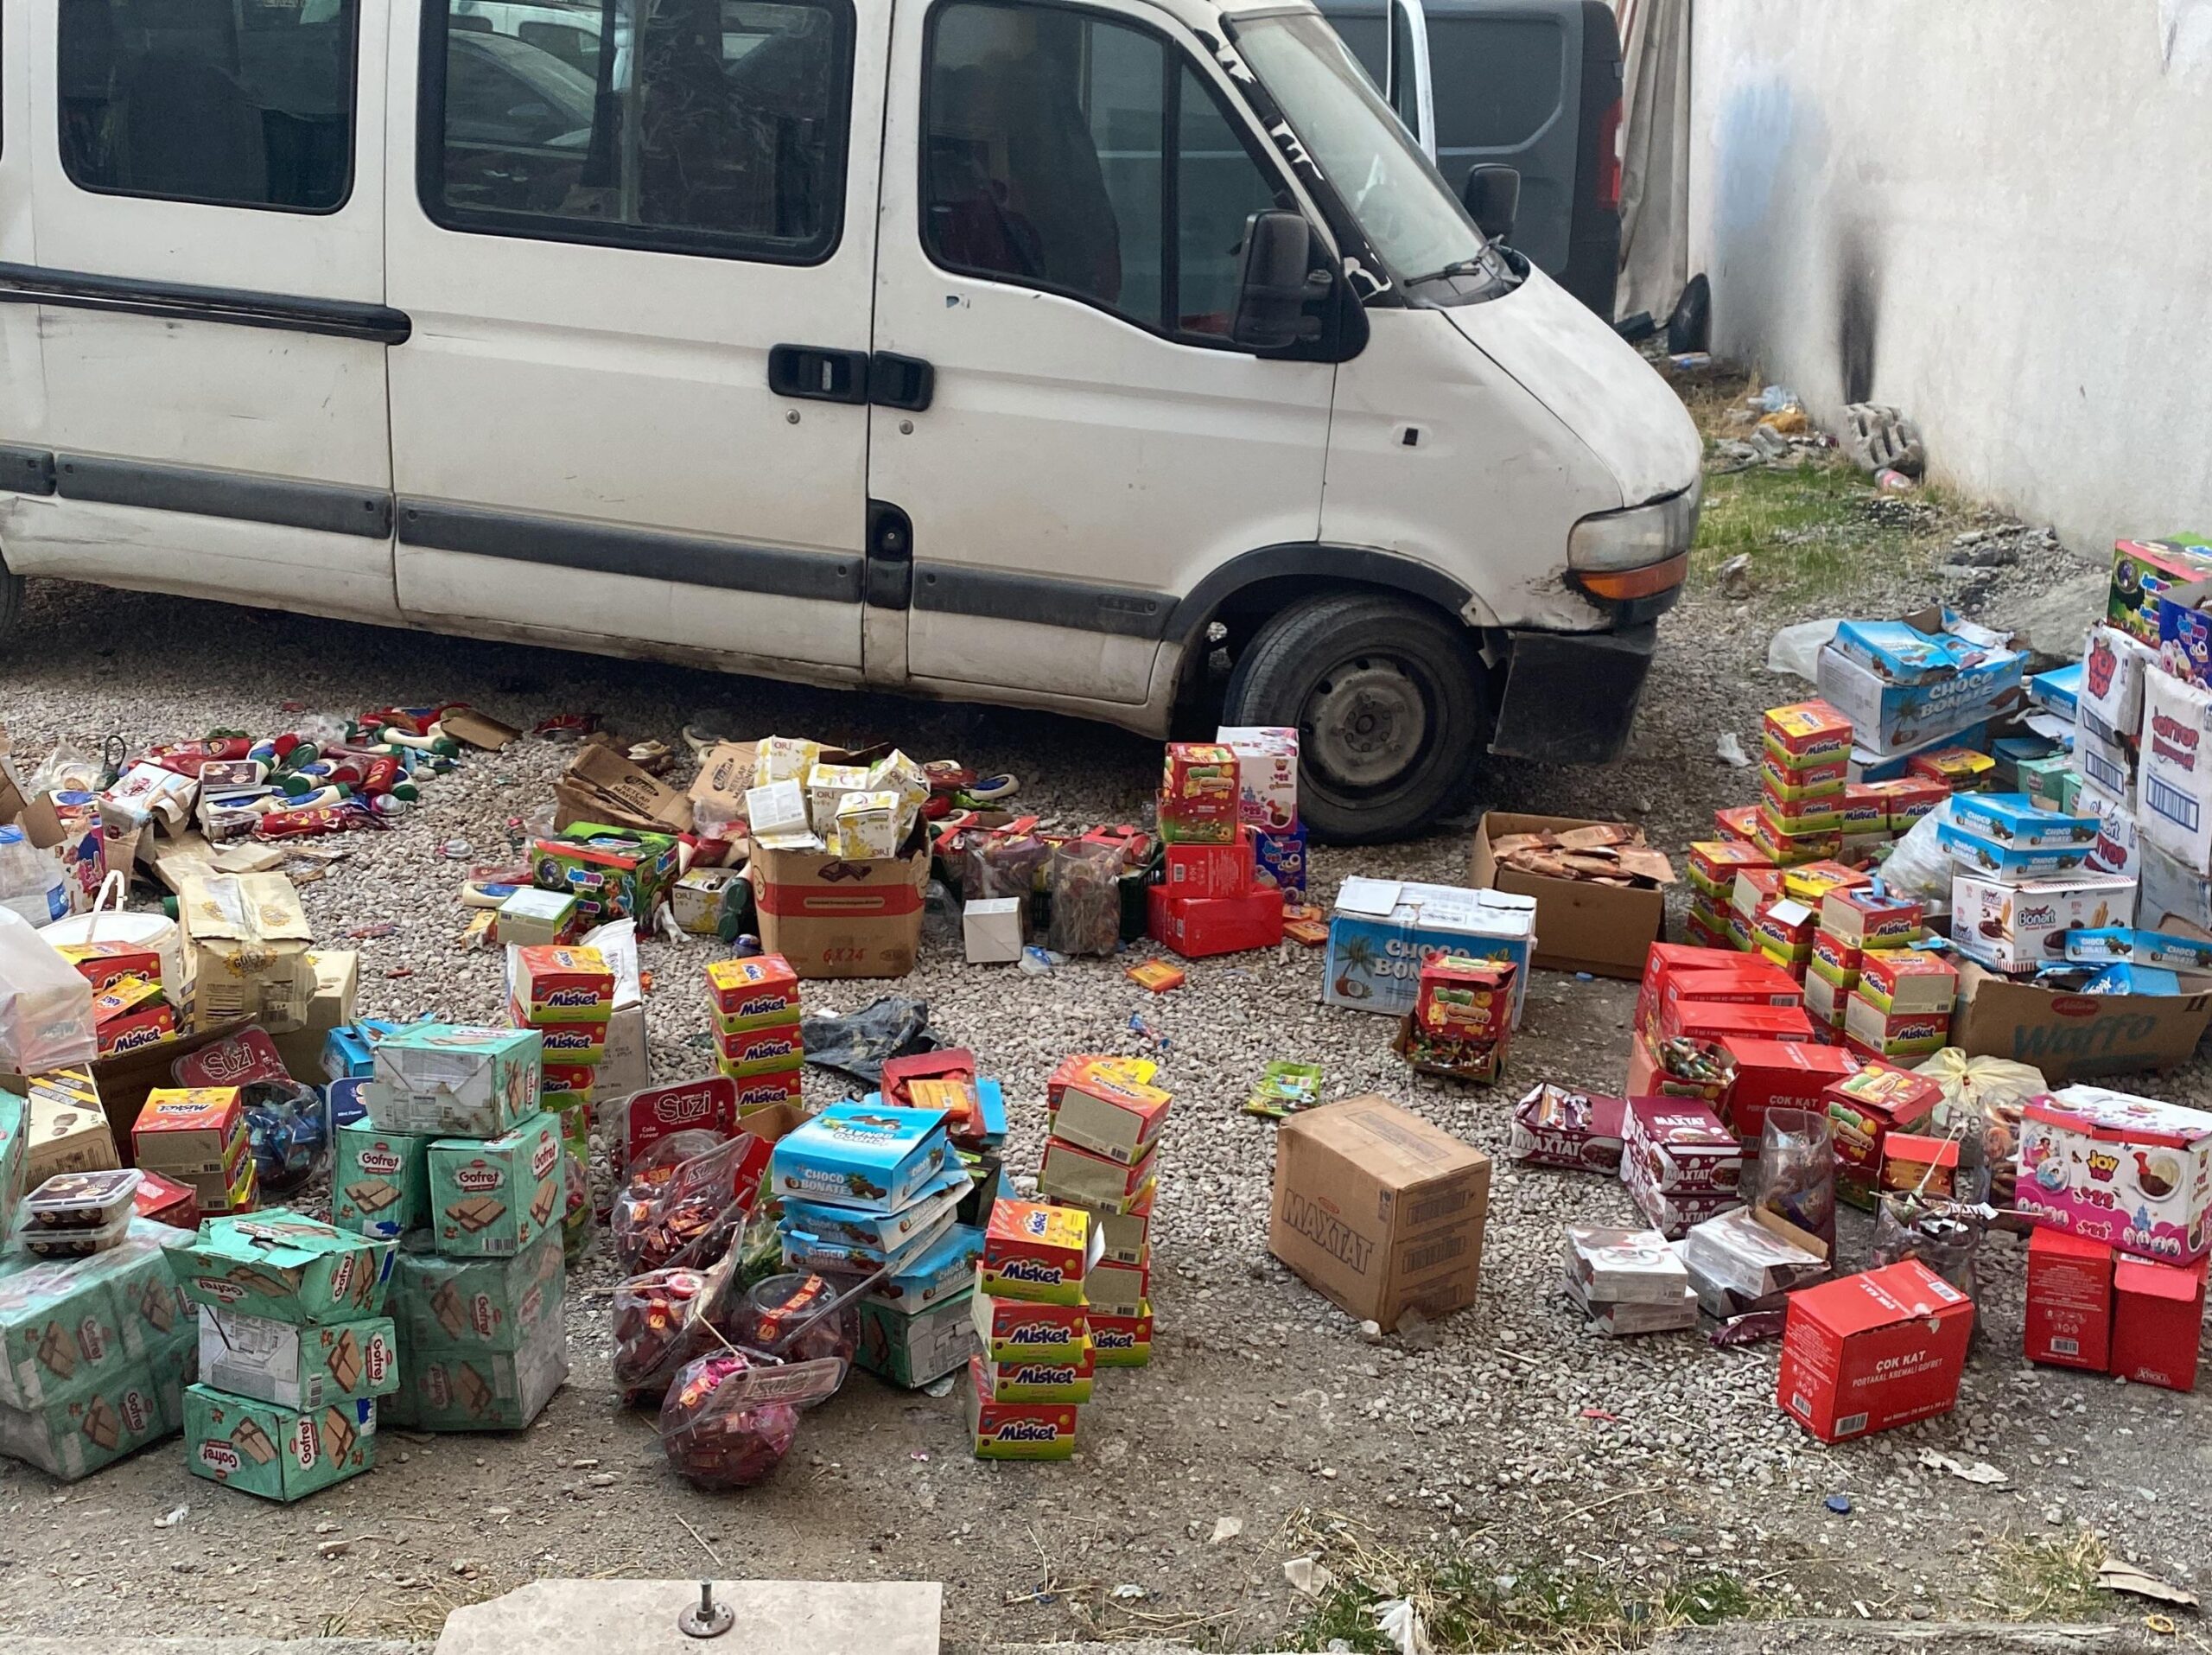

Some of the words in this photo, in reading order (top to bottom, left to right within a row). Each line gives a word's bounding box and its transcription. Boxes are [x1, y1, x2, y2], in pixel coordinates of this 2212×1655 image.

[1806, 742, 1840, 755] Misket
[1845, 810, 1877, 821] Misket
[1967, 812, 1991, 824] CHOCO
[1954, 840, 1977, 854] CHOCO
[2018, 909, 2056, 926] Bonart
[1761, 922, 1787, 943] Misket
[1877, 921, 1910, 937] Misket
[2082, 938, 2105, 946] CHOCO
[2167, 945, 2197, 957] CHOCO
[1818, 946, 1839, 968] Misket
[1375, 958, 1421, 982] BON
[1866, 972, 1887, 995] Misket
[546, 990, 598, 1008] Misket
[739, 998, 787, 1018] Misket
[114, 1028, 161, 1053] Misket
[543, 1035, 592, 1049] Misket
[1898, 1027, 1935, 1041] Misket
[202, 1043, 254, 1079] Suzi
[744, 1043, 792, 1062] Misket
[740, 1088, 788, 1105] Misket
[1796, 1097, 1819, 1107] KAT
[658, 1092, 711, 1123] Suzi
[642, 1125, 656, 1134] Cola
[1654, 1116, 1707, 1127] MAXTAT
[639, 1131, 659, 1140] Flavor
[1515, 1131, 1583, 1158] MAXTAT
[362, 1152, 400, 1168] Gofret
[2087, 1149, 2120, 1172] JOY
[459, 1170, 500, 1184] Gofret
[805, 1168, 844, 1185] CHOCO
[1666, 1168, 1710, 1181] MAXTAT
[801, 1180, 850, 1195] BONATE
[1664, 1211, 1710, 1224] MAXTAT
[1281, 1188, 1375, 1276] MAXTAT
[334, 1256, 353, 1298] Gofret
[938, 1260, 966, 1281] CHOCO
[1001, 1260, 1062, 1286] Misket
[199, 1277, 245, 1296] Gofret
[478, 1295, 492, 1337] Gofret
[1009, 1323, 1071, 1346] Misket
[372, 1338, 383, 1382] Gofret
[1876, 1356, 1900, 1372] ÇOK
[1903, 1350, 1926, 1366] KAT
[1015, 1365, 1074, 1385] Misket
[1853, 1372, 1888, 1388] PORTAKAL
[1918, 1358, 1943, 1372] GOFRET
[128, 1391, 145, 1432] Gofret
[996, 1422, 1057, 1442] Misket
[301, 1420, 313, 1464] Gofret
[203, 1447, 238, 1469] Gofret
